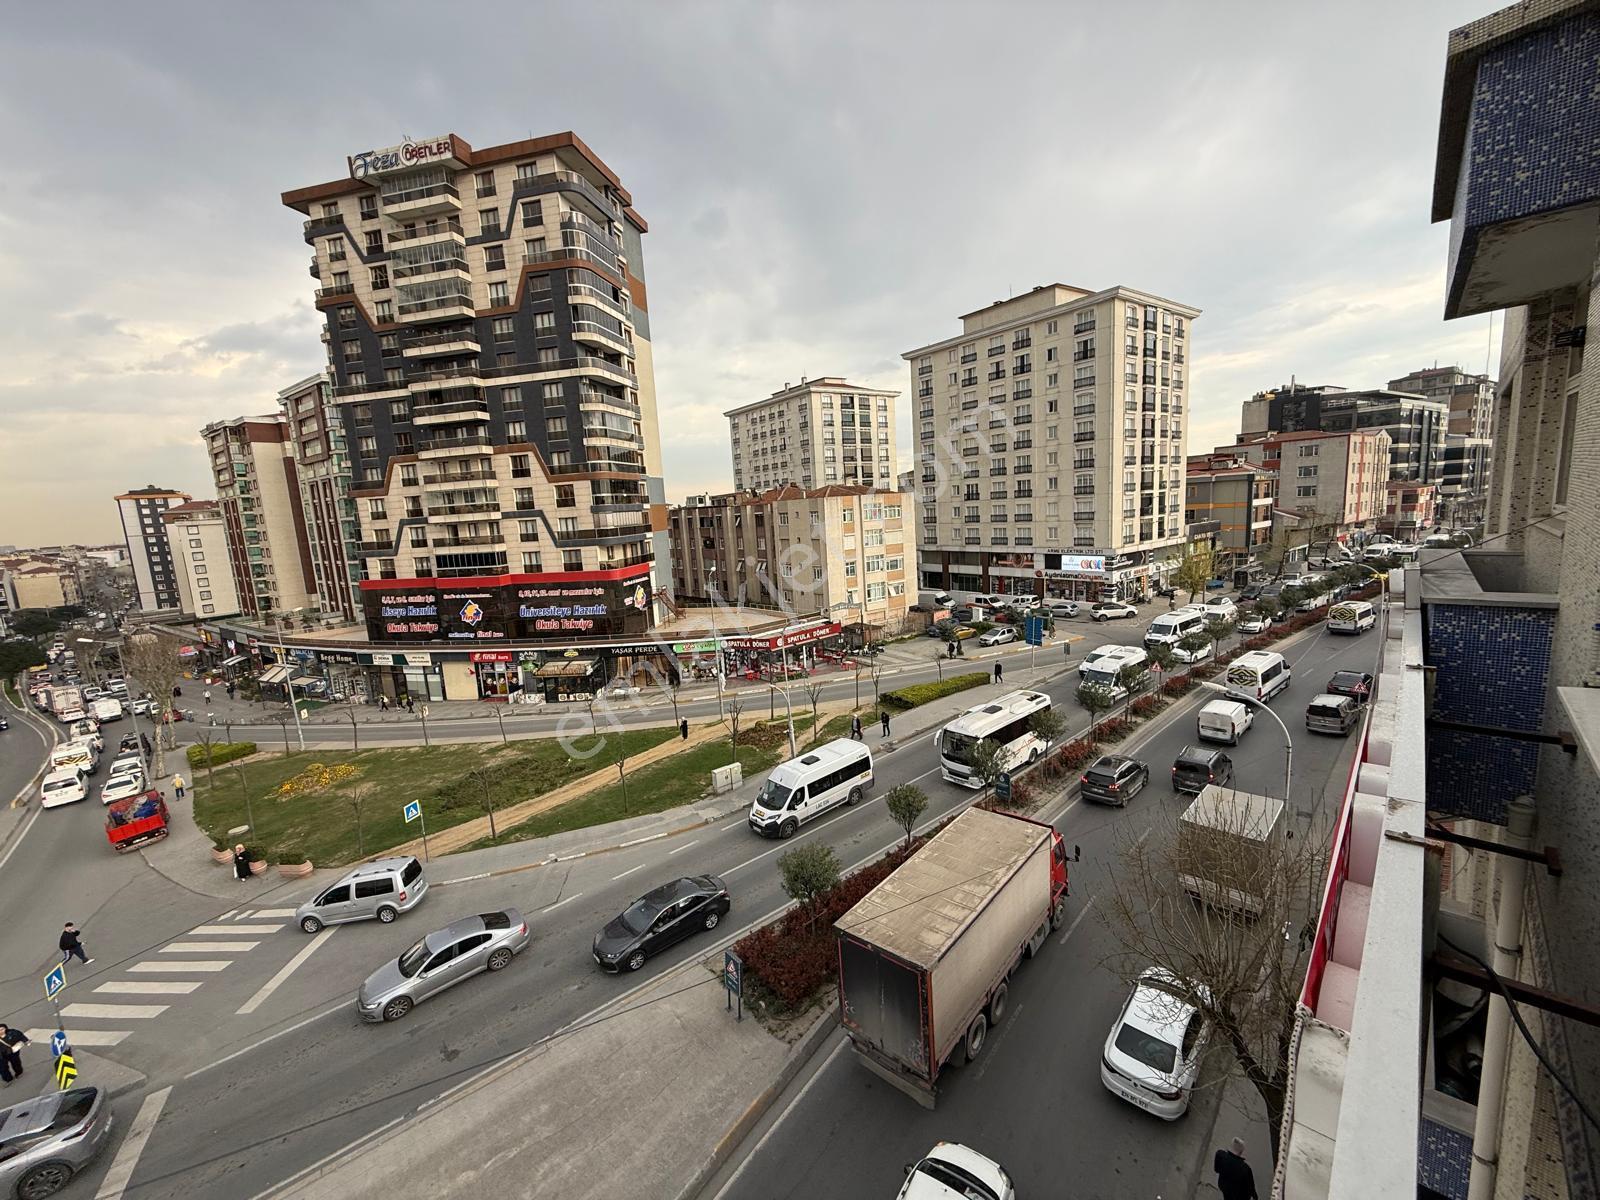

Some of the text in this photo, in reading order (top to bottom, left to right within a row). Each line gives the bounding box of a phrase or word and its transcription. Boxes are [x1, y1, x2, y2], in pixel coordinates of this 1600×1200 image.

[353, 150, 400, 180] Feza
[381, 606, 407, 618] Liseye
[519, 604, 571, 618] Üniversiteye
[386, 621, 439, 634] Okula Takviye
[535, 617, 594, 631] Okula Takviye
[787, 627, 831, 644] SPATULA DÖNER
[635, 645, 658, 654] PERDE
[752, 640, 770, 648] DÖNER
